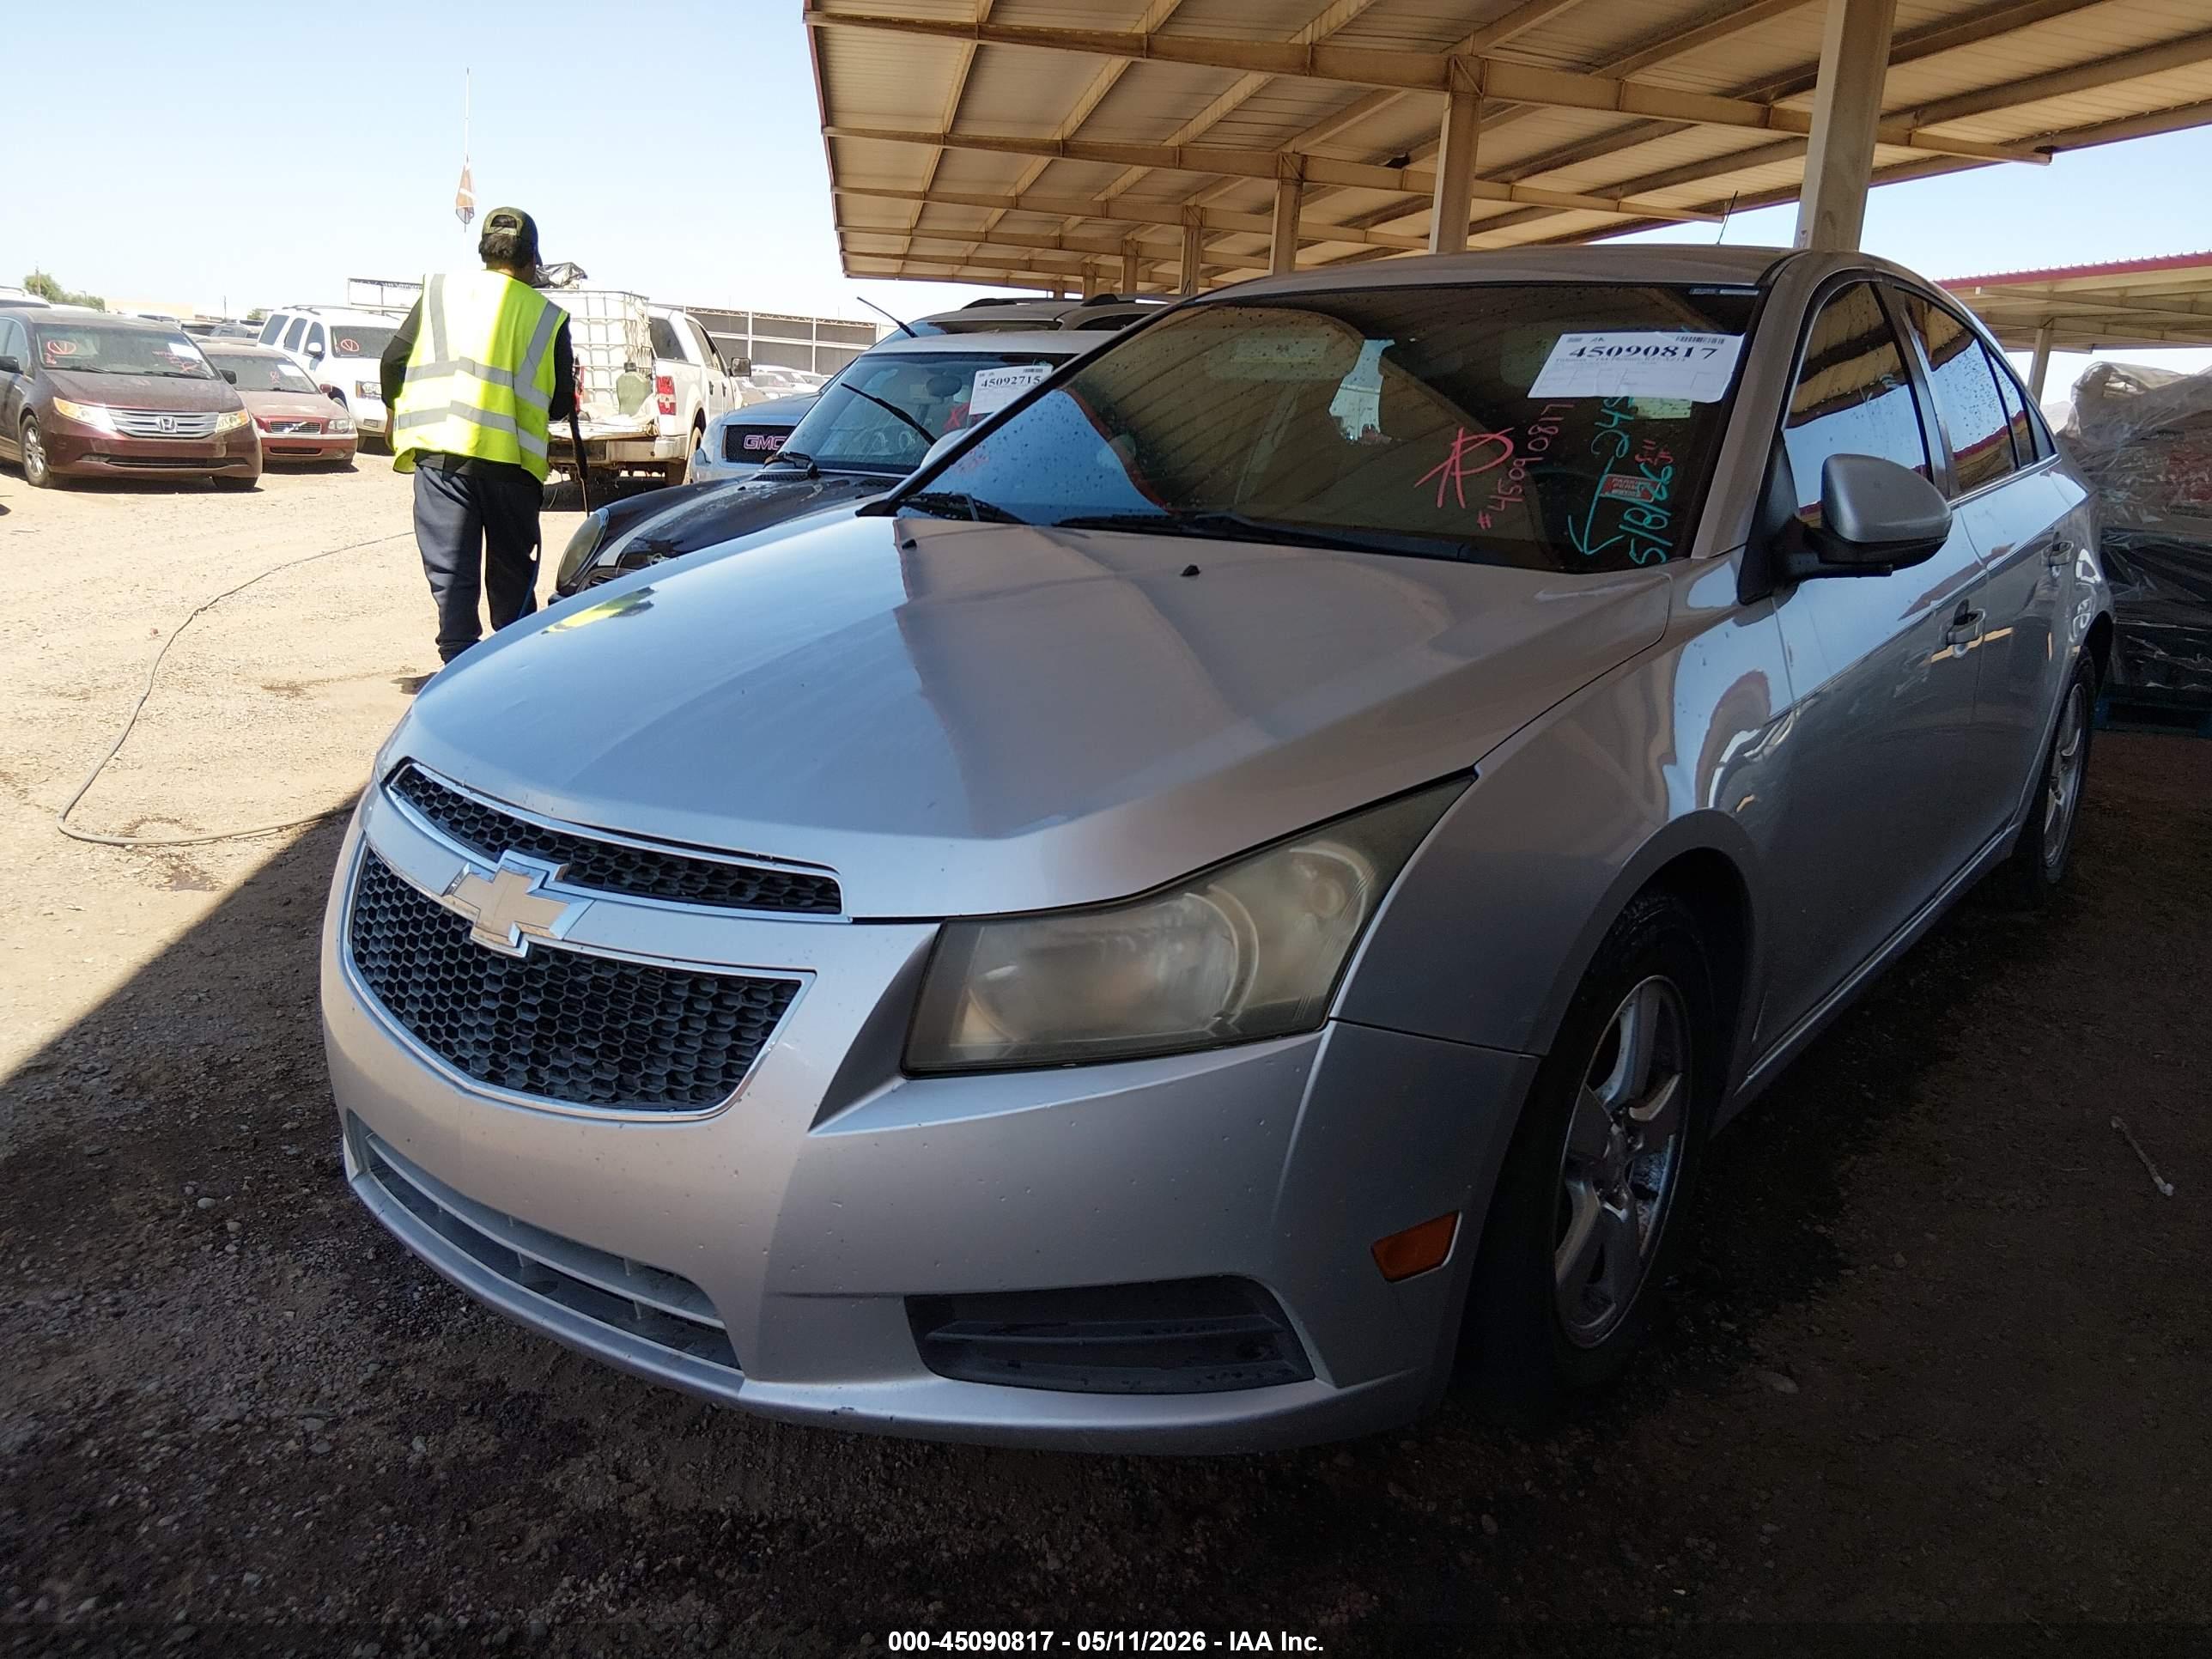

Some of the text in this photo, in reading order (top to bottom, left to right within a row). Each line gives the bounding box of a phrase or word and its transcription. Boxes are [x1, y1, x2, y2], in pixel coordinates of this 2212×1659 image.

[1569, 345, 1719, 360] 45090817
[980, 374, 1042, 388] 45092715
[743, 434, 787, 451] GMC
